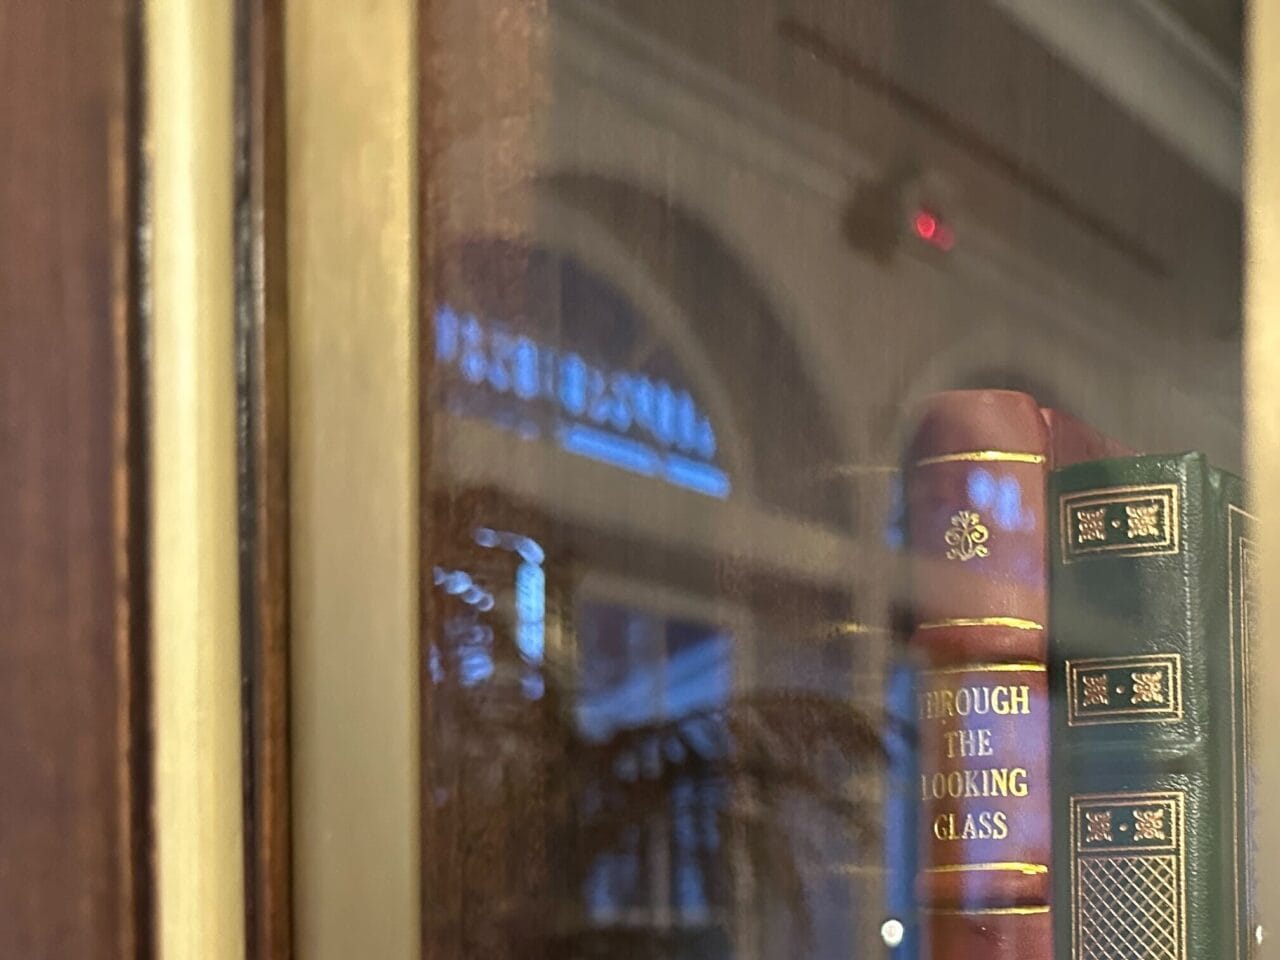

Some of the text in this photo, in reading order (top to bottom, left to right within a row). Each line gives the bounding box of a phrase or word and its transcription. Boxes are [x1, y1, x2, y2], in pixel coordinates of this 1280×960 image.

[943, 728, 994, 758] THE
[921, 767, 1029, 801] LOOKING
[933, 810, 1009, 841] GLASS
